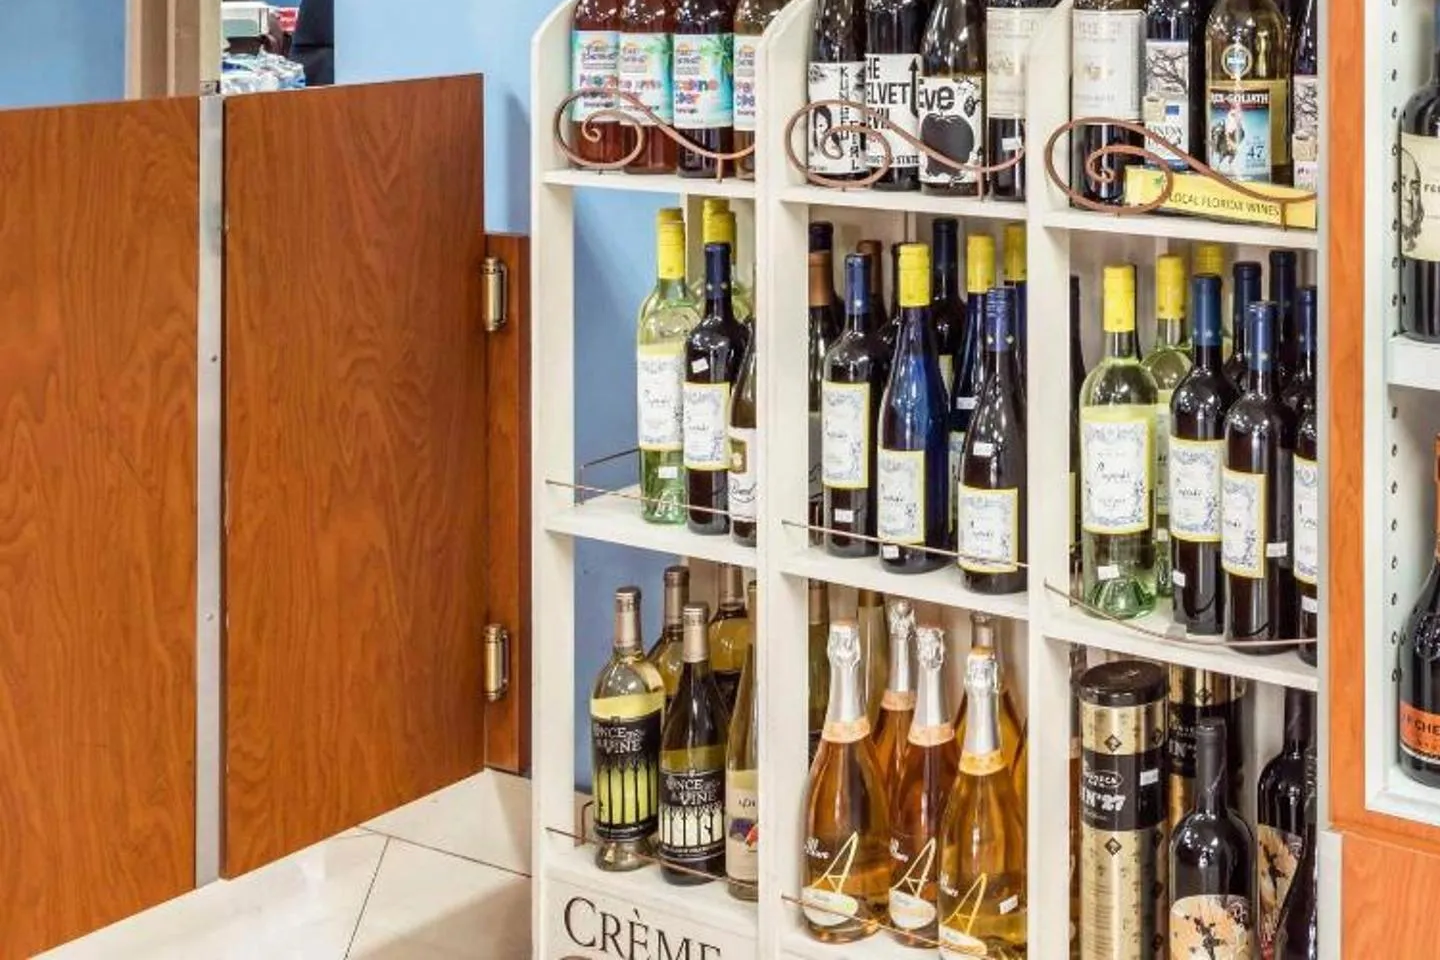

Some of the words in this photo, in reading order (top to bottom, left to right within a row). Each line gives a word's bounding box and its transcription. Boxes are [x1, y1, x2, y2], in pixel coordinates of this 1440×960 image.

[1246, 144, 1265, 161] 47
[1169, 190, 1199, 206] LOCAL
[1246, 200, 1280, 217] WINES
